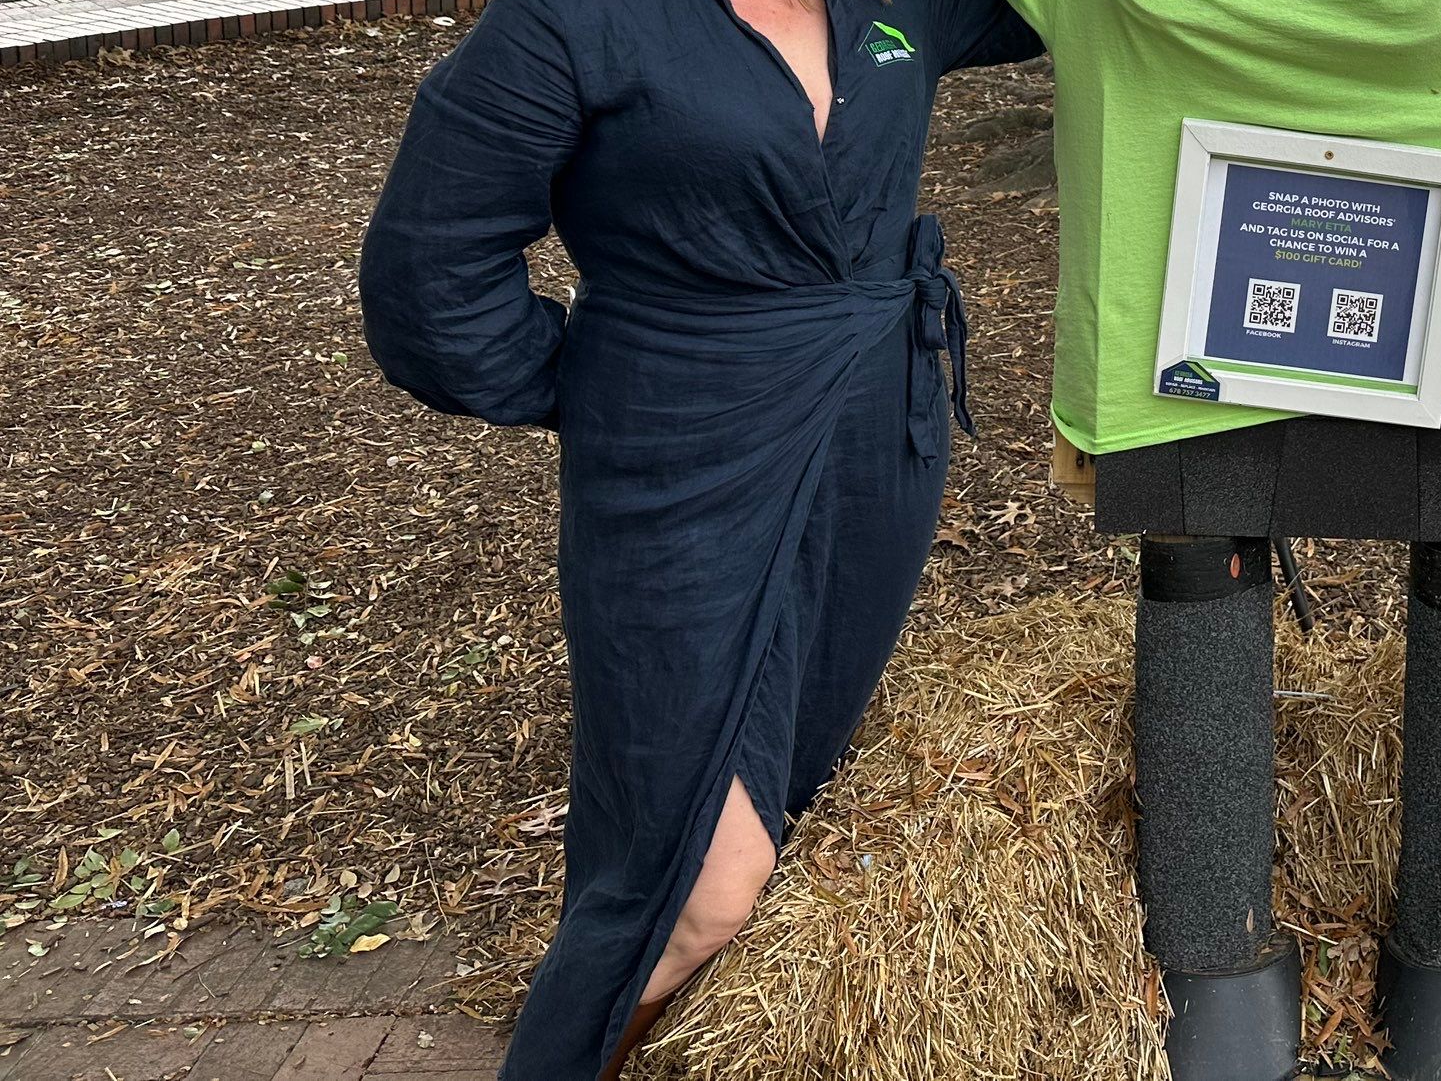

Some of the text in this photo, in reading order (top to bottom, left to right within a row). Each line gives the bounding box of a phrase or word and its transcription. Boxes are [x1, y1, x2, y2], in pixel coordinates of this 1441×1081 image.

[1252, 202, 1302, 216] GEORGIA
[1304, 208, 1336, 218] ROOF
[1268, 192, 1380, 214] SNAP A PHOTO WITH
[1291, 218, 1352, 233] MARY ETTA
[1240, 223, 1400, 250] AND TAG US ON SOCIAL FOR A
[1270, 238, 1367, 258] CHANCE TO WIN A
[1275, 249, 1362, 268] $100 GIFT CARD!
[1246, 330, 1282, 338] FACEBOOK
[1332, 338, 1370, 348] INSTAGRAM
